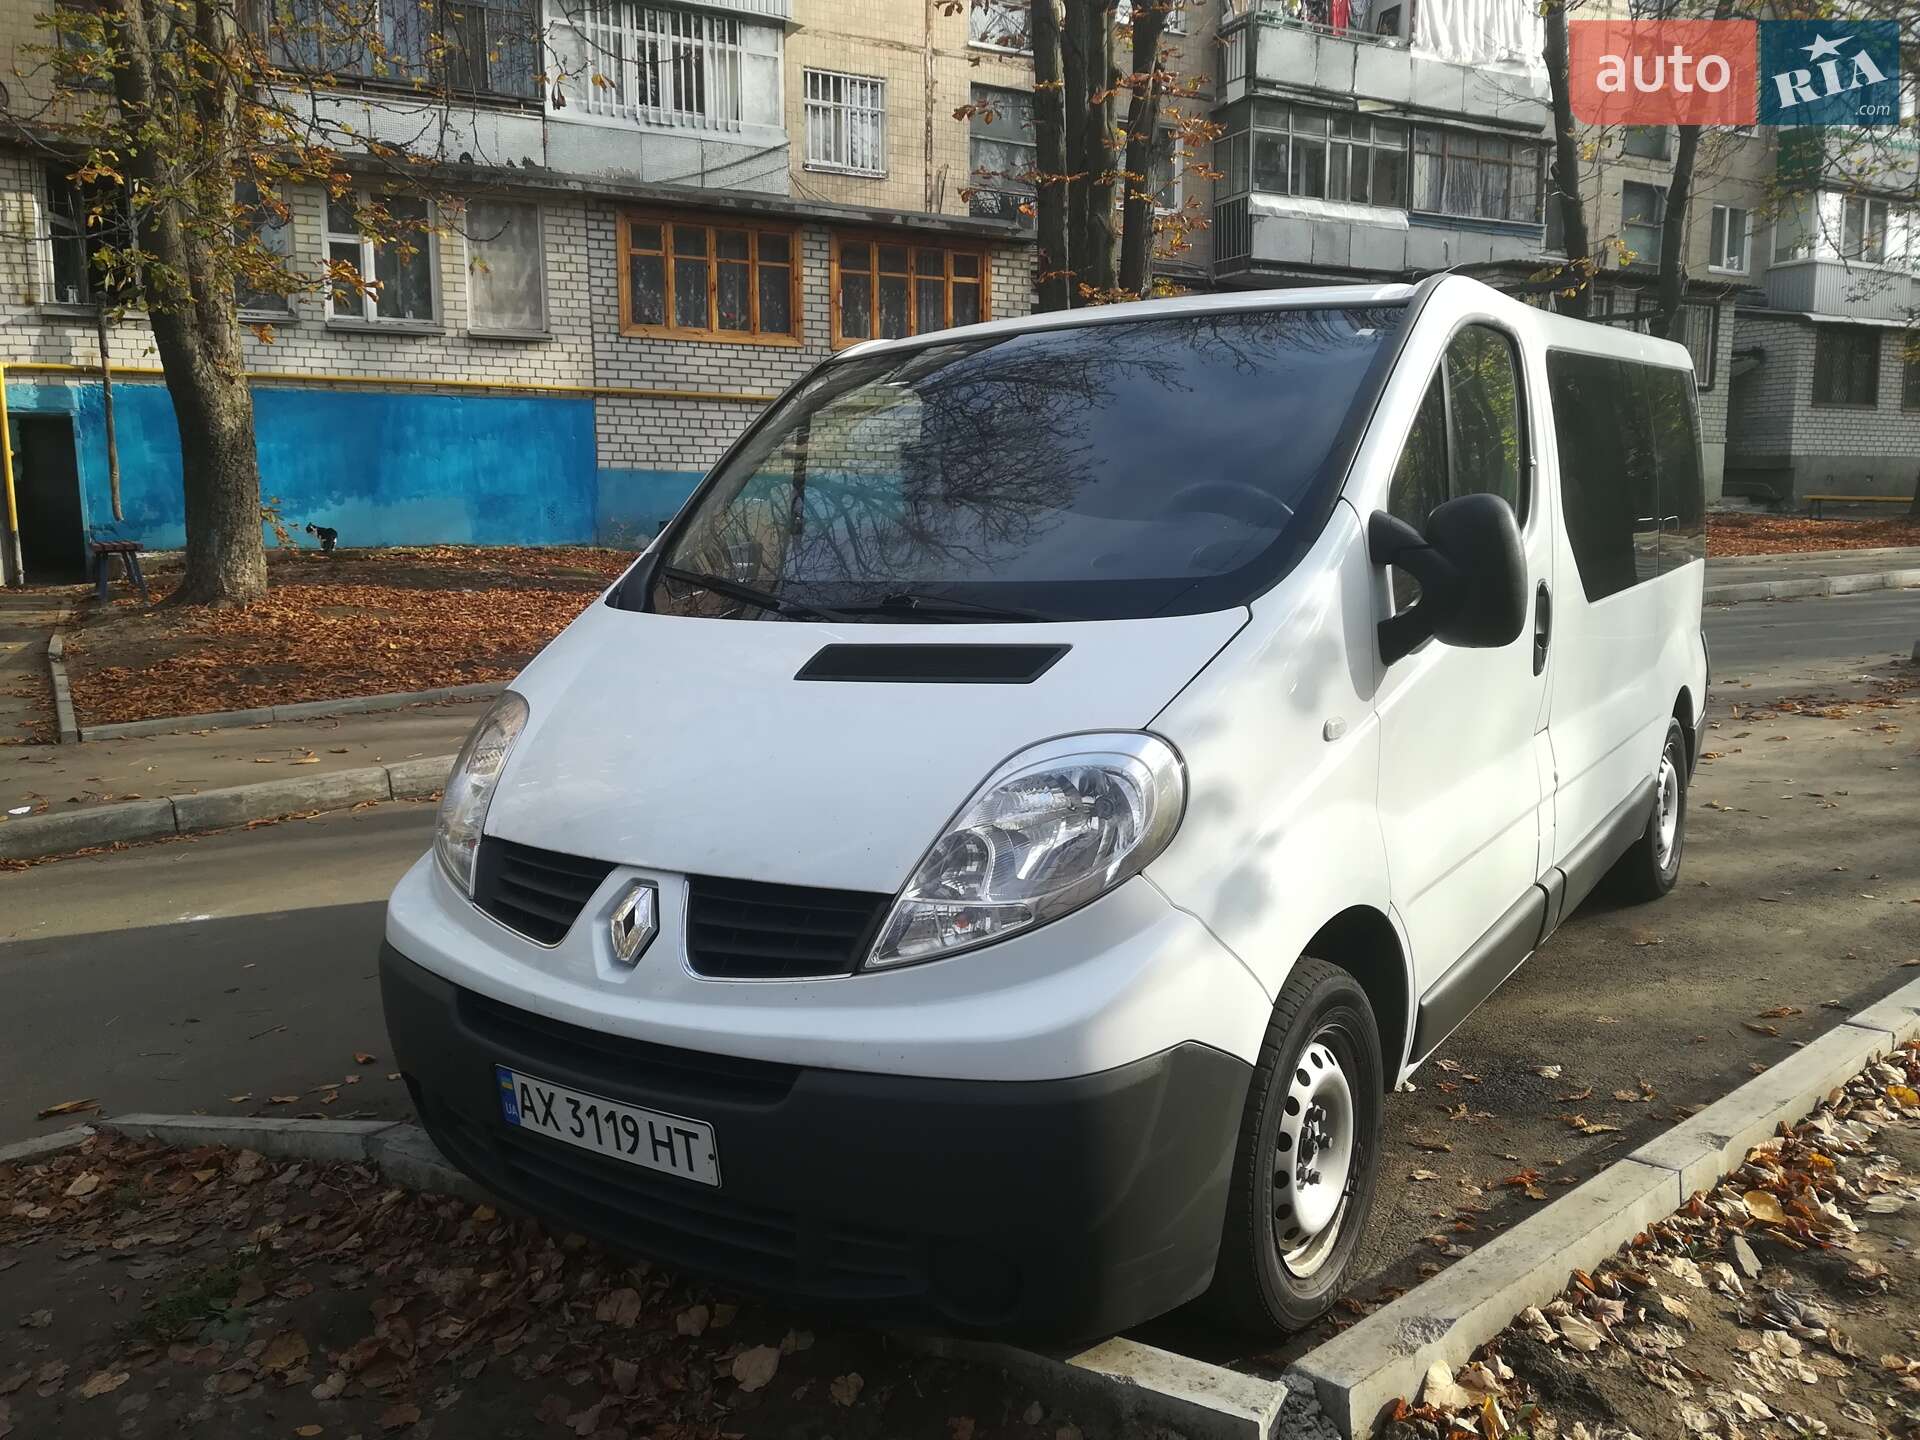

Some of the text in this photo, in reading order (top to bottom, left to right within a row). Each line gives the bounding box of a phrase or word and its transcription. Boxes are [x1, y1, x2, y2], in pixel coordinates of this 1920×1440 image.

[505, 1103, 519, 1117] UA
[520, 1082, 699, 1172] AX 3119 HT
